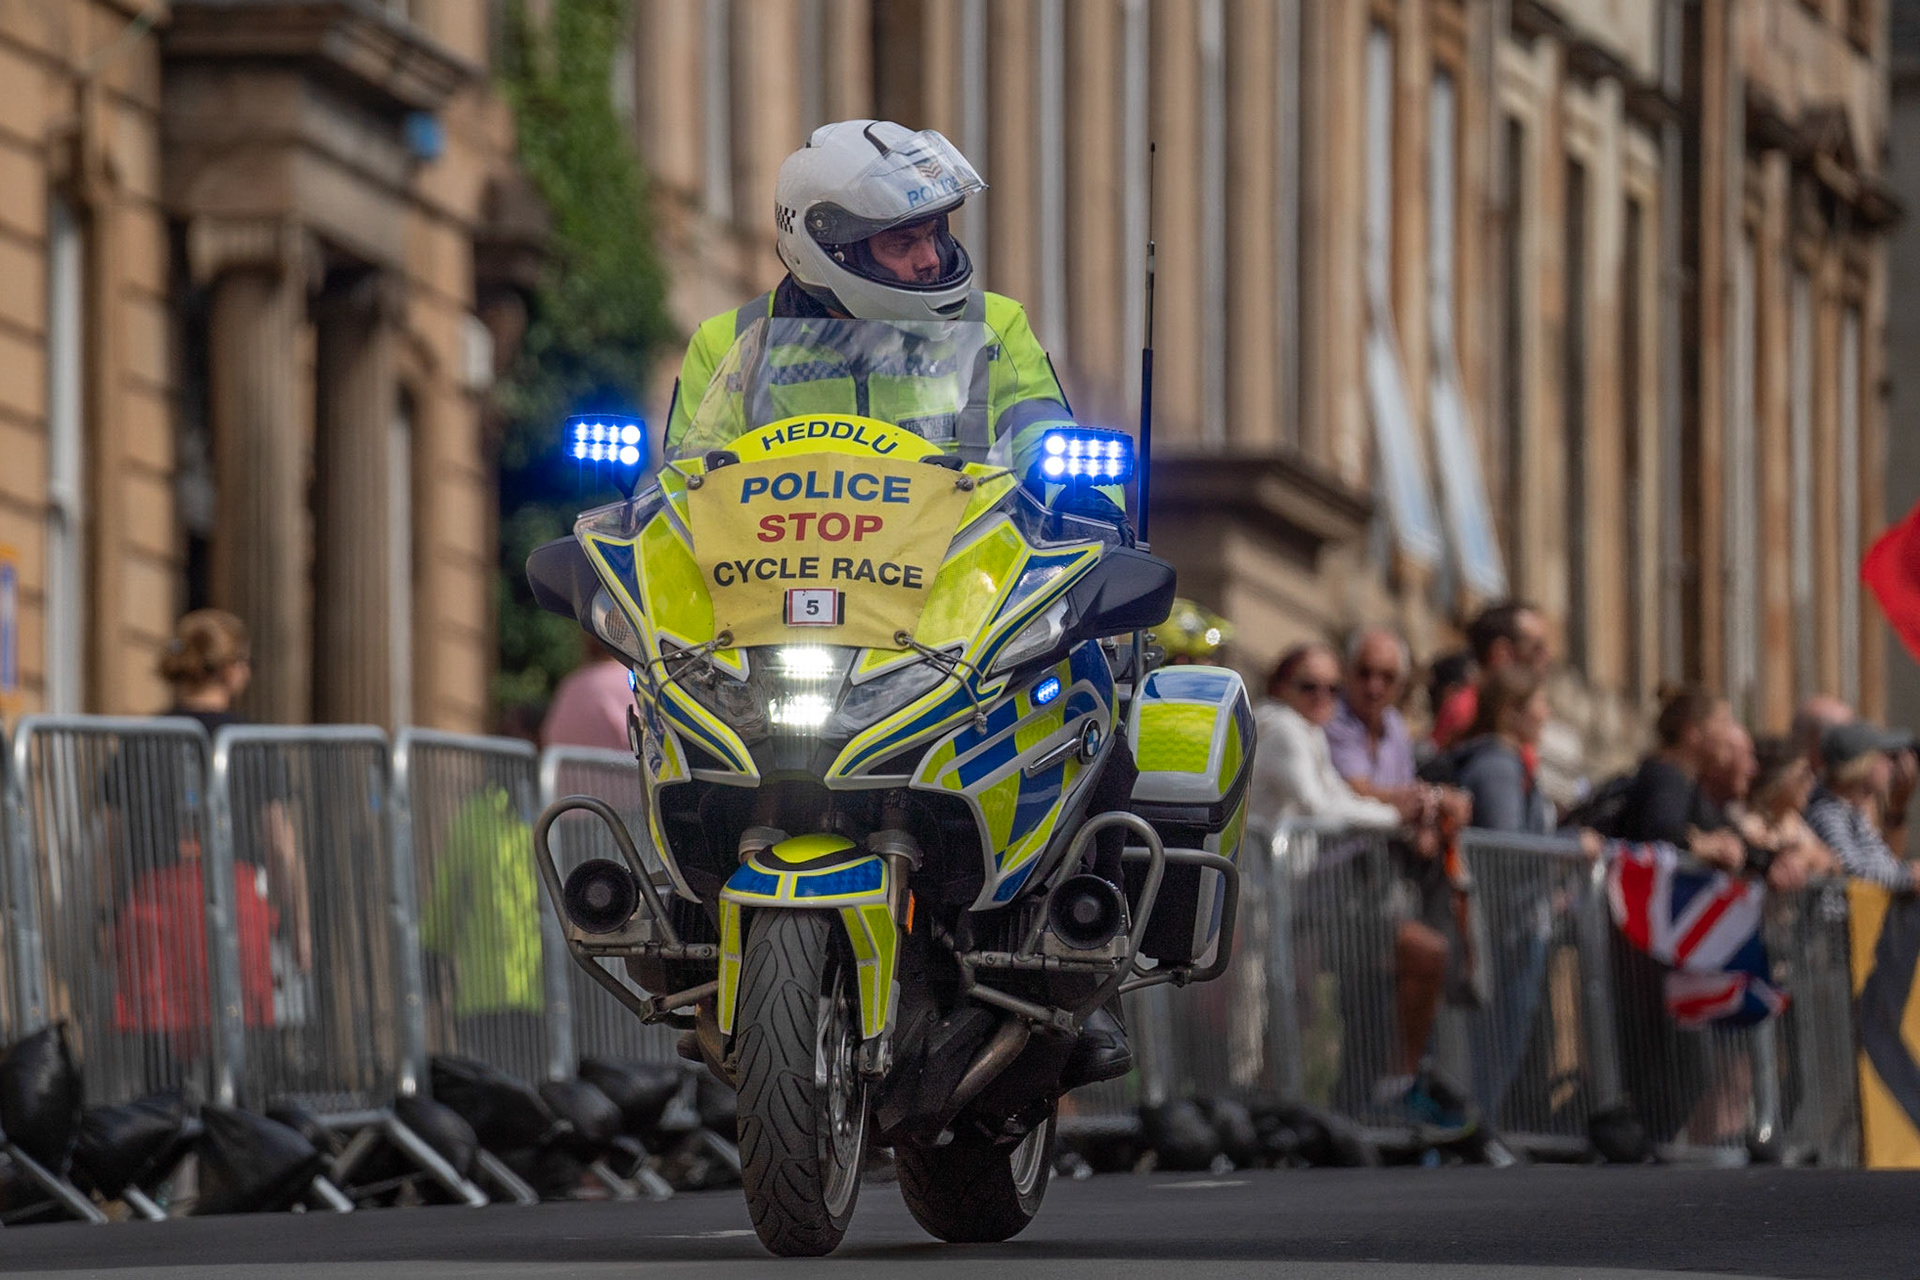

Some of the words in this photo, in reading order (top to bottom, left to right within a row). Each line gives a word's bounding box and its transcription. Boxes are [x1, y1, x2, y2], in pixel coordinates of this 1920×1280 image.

[761, 421, 898, 454] HEDDLU
[740, 470, 911, 504] POLICE
[757, 512, 883, 543] STOP
[713, 557, 820, 587] CYCLE
[831, 557, 923, 590] RACE
[805, 599, 820, 616] 5
